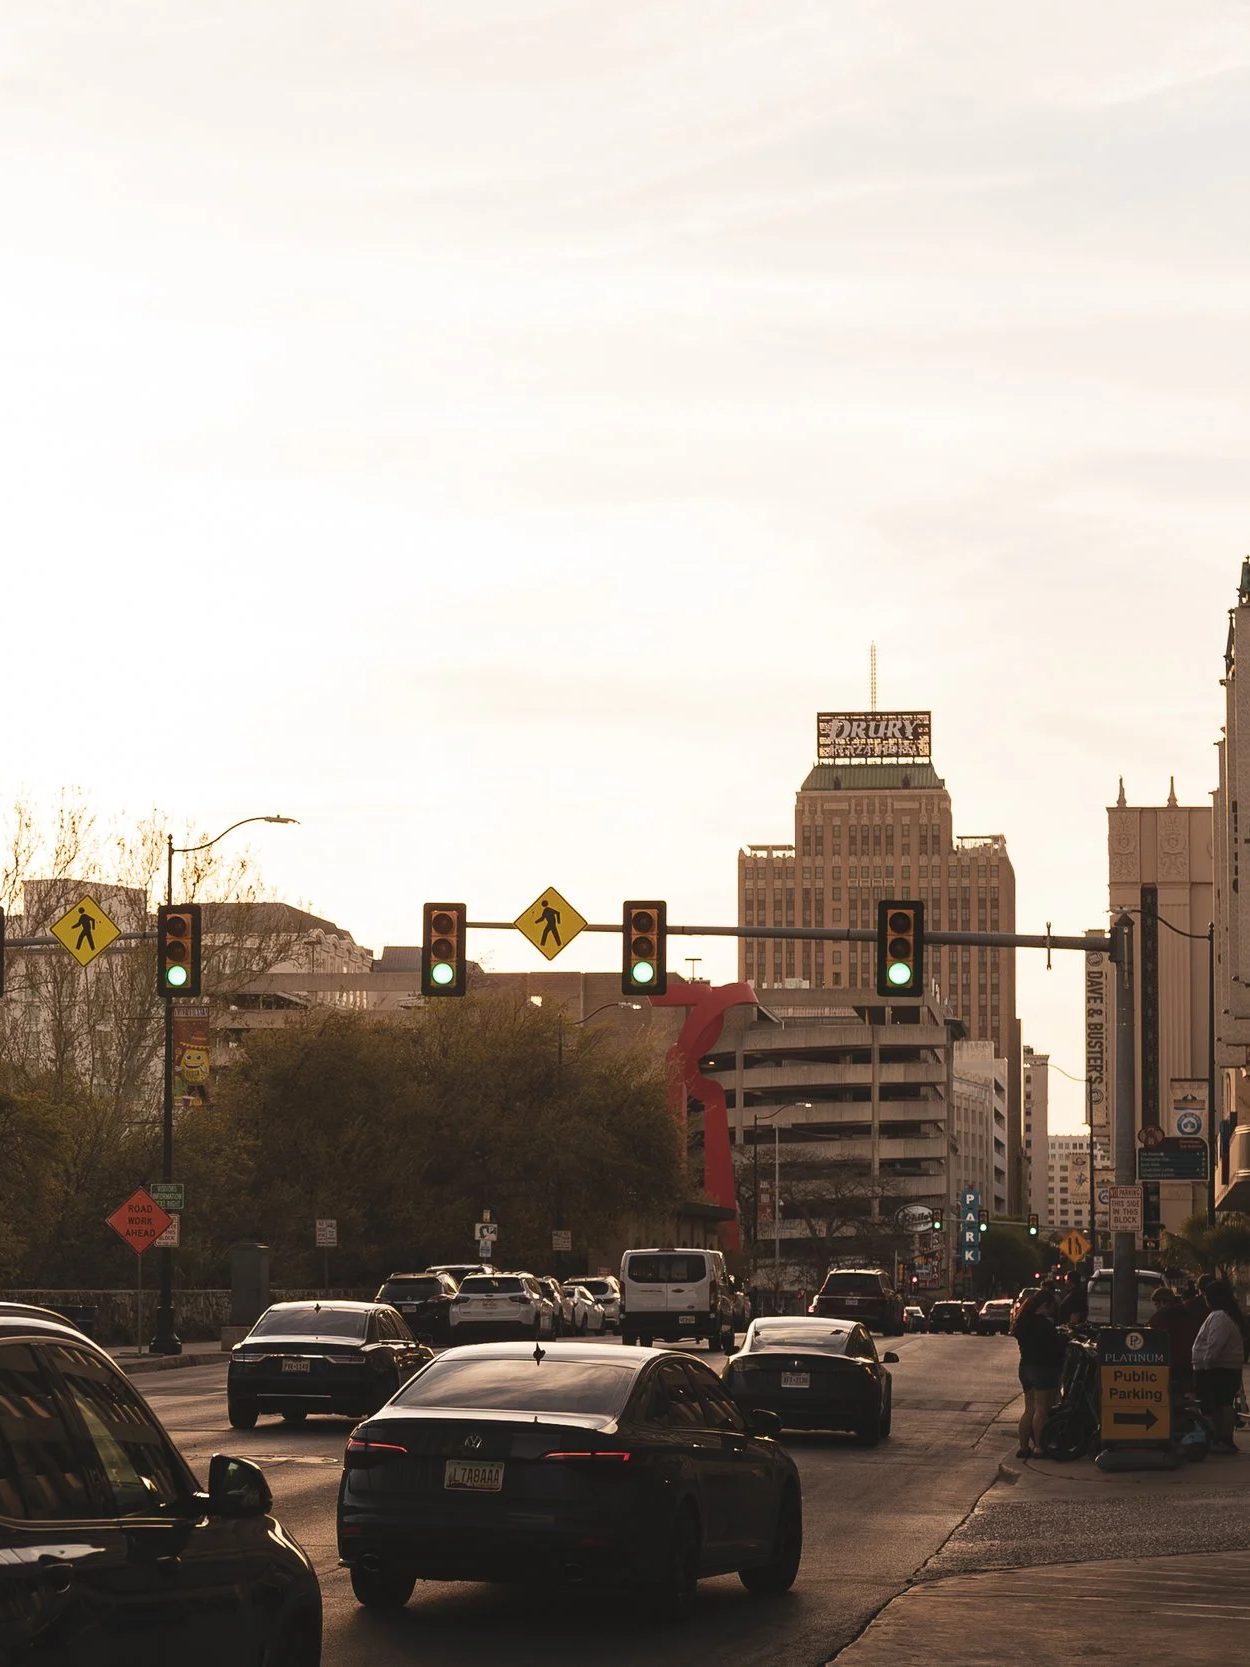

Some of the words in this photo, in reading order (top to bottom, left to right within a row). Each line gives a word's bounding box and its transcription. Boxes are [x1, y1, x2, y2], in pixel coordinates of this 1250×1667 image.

[828, 719, 920, 740] DRURY
[1087, 971, 1103, 1003] DAVE
[1087, 1008, 1103, 1018] &
[1087, 1022, 1104, 1084] BUSTER'S
[1119, 1189, 1140, 1197] PARKING
[128, 1204, 153, 1213] ROAD
[128, 1217, 152, 1225] WORK
[1114, 1216, 1137, 1224] BLOCK
[965, 1194, 975, 1261] PARK
[125, 1229, 156, 1238] AHEAD
[1105, 1353, 1164, 1362] PLATINUM
[1114, 1370, 1158, 1383] Public
[1110, 1388, 1163, 1402] Parking
